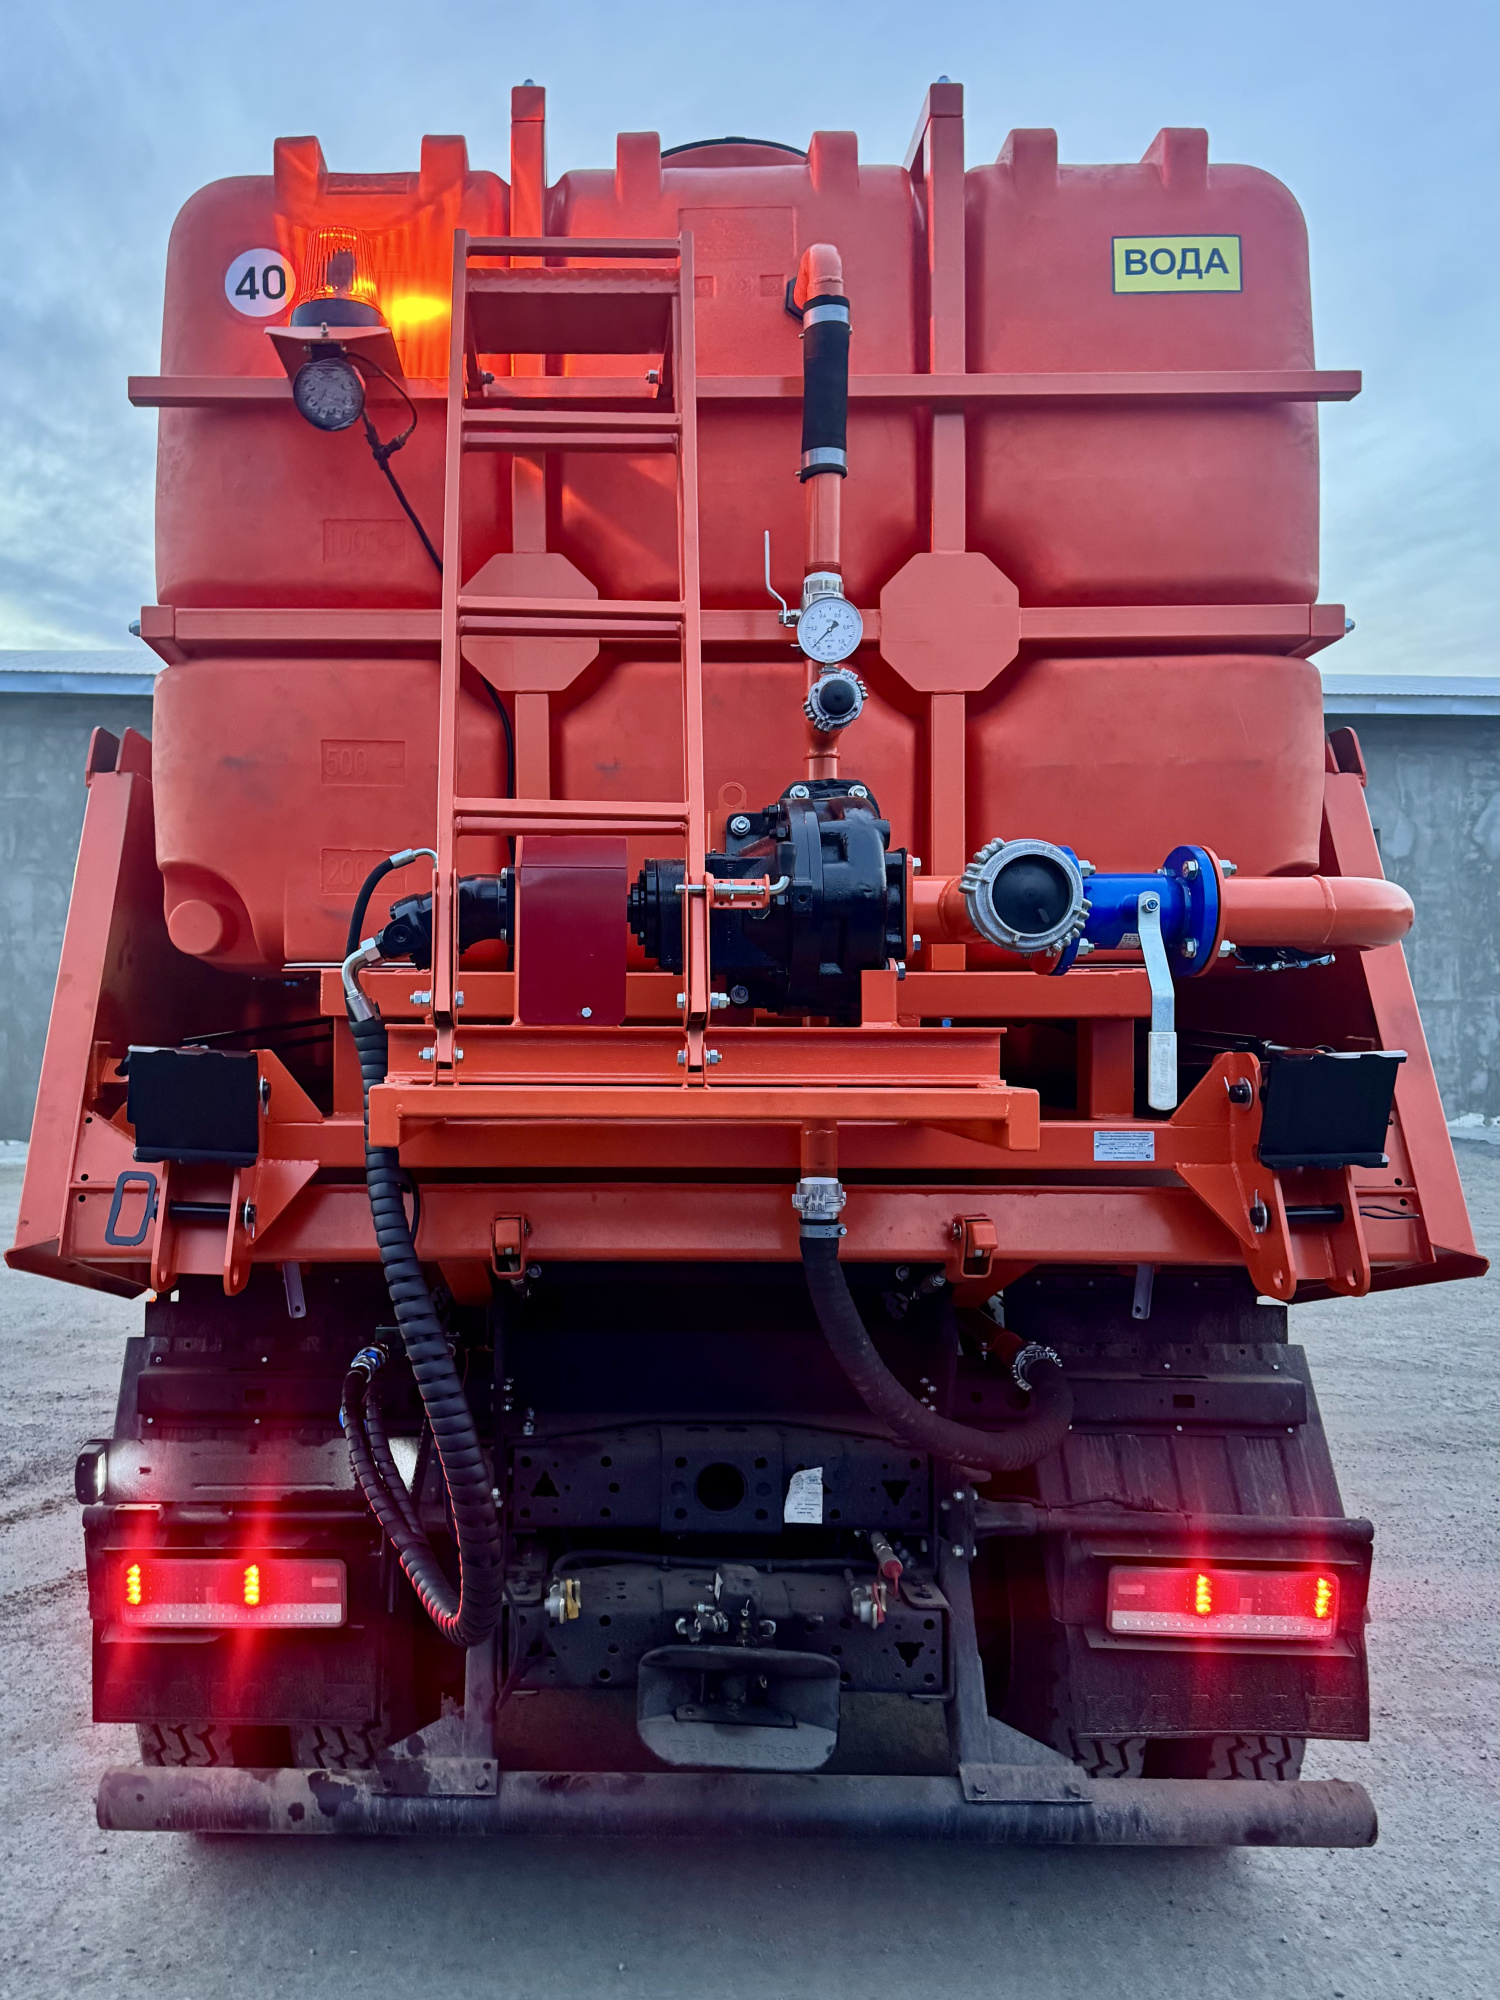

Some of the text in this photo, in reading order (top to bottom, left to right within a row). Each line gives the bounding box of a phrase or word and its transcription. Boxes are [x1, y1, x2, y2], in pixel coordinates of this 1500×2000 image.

[1124, 248, 1229, 280] ВОДА
[235, 265, 286, 300] 40
[325, 748, 367, 777] 500
[326, 858, 366, 887] 200
